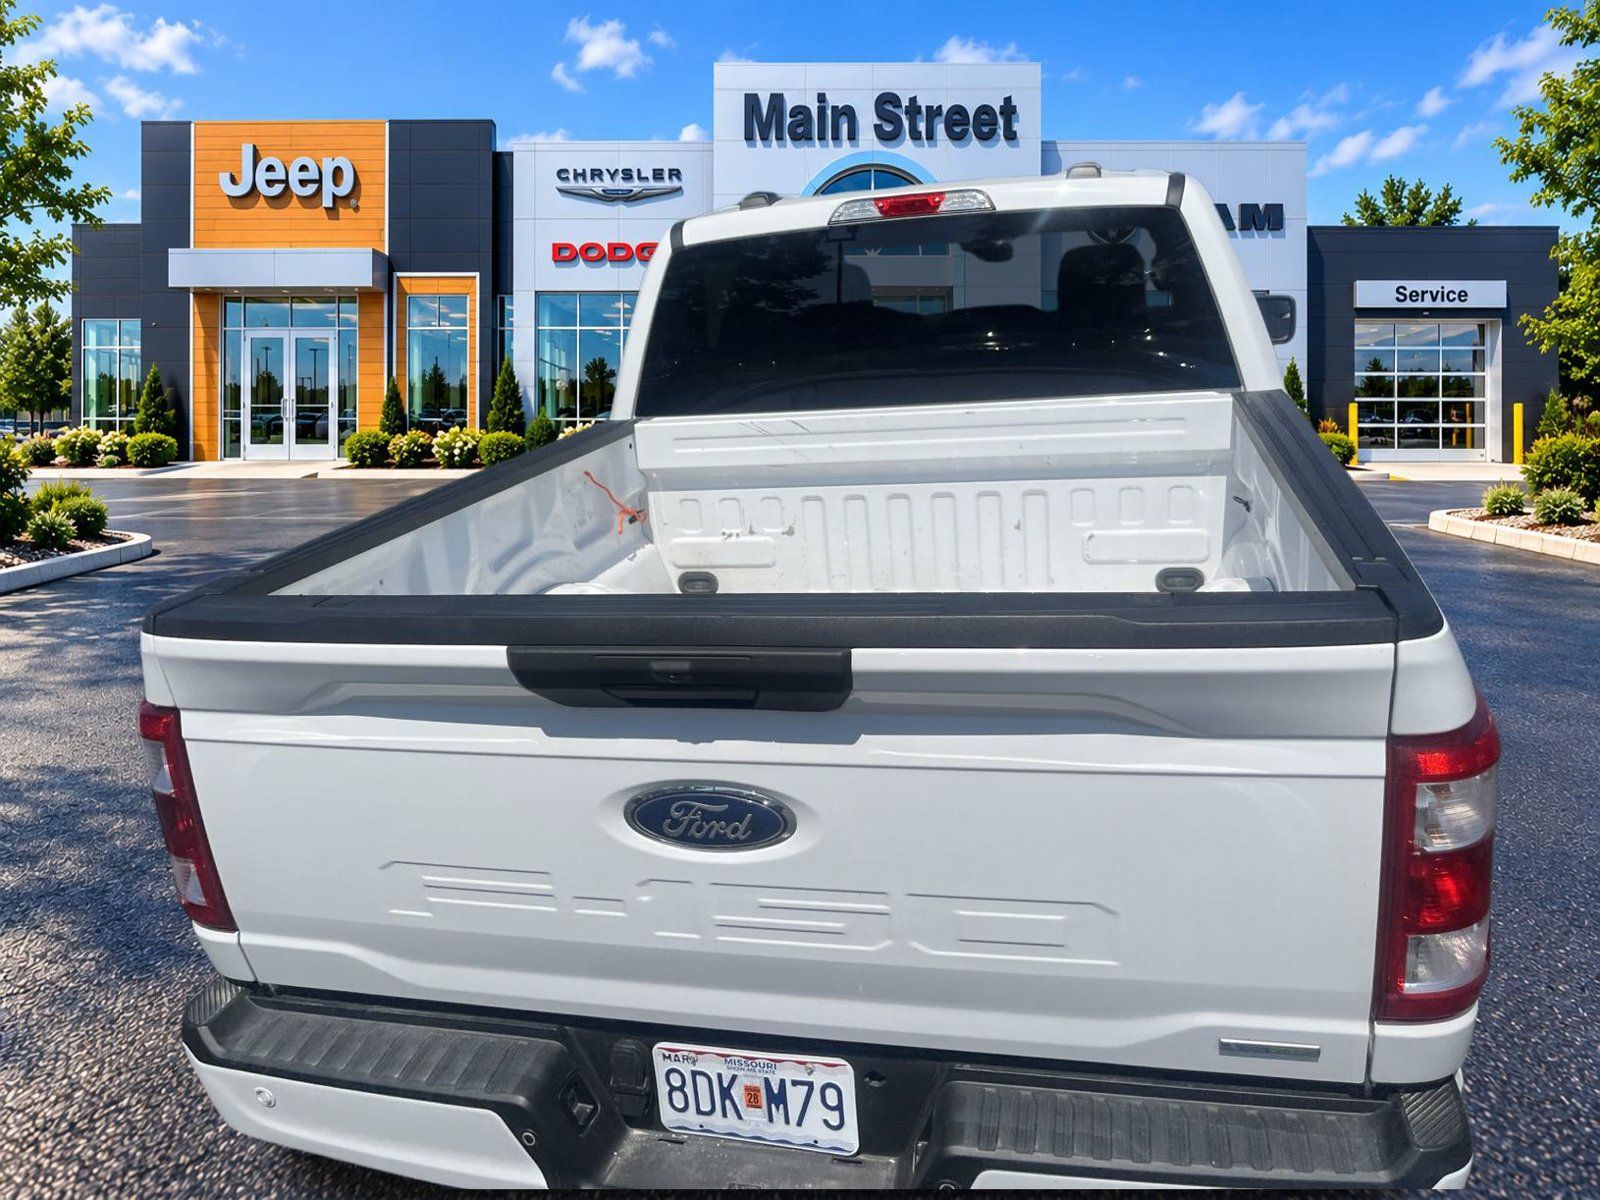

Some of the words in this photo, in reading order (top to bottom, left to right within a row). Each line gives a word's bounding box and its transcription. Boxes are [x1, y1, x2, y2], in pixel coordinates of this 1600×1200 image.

[744, 92, 856, 141] Main
[873, 91, 1017, 141] Street
[219, 143, 354, 208] Jeep
[556, 168, 682, 182] CHRYSLER
[552, 242, 659, 263] DODG
[1395, 285, 1469, 303] Service
[662, 800, 752, 840] Ford
[724, 1058, 777, 1070] MISSOURI
